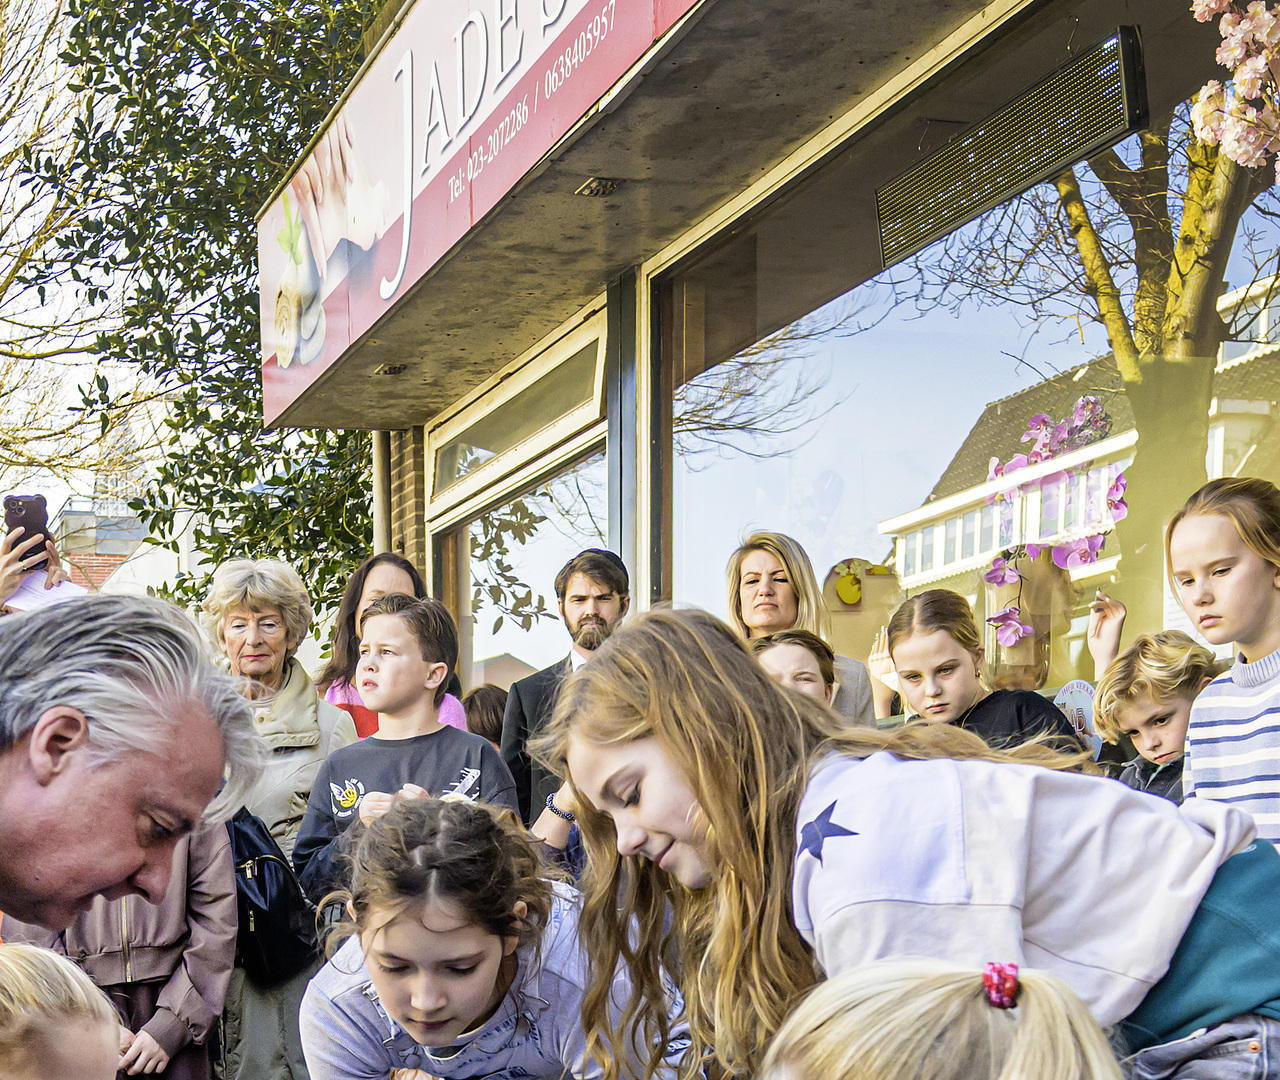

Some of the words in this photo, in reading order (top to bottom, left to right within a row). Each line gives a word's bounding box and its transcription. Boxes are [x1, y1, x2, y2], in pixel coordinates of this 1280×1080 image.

[448, 167, 466, 204] Tel:
[467, 93, 529, 184] 023-2072286
[534, 80, 539, 114] /
[544, 0, 617, 100] 0638405957
